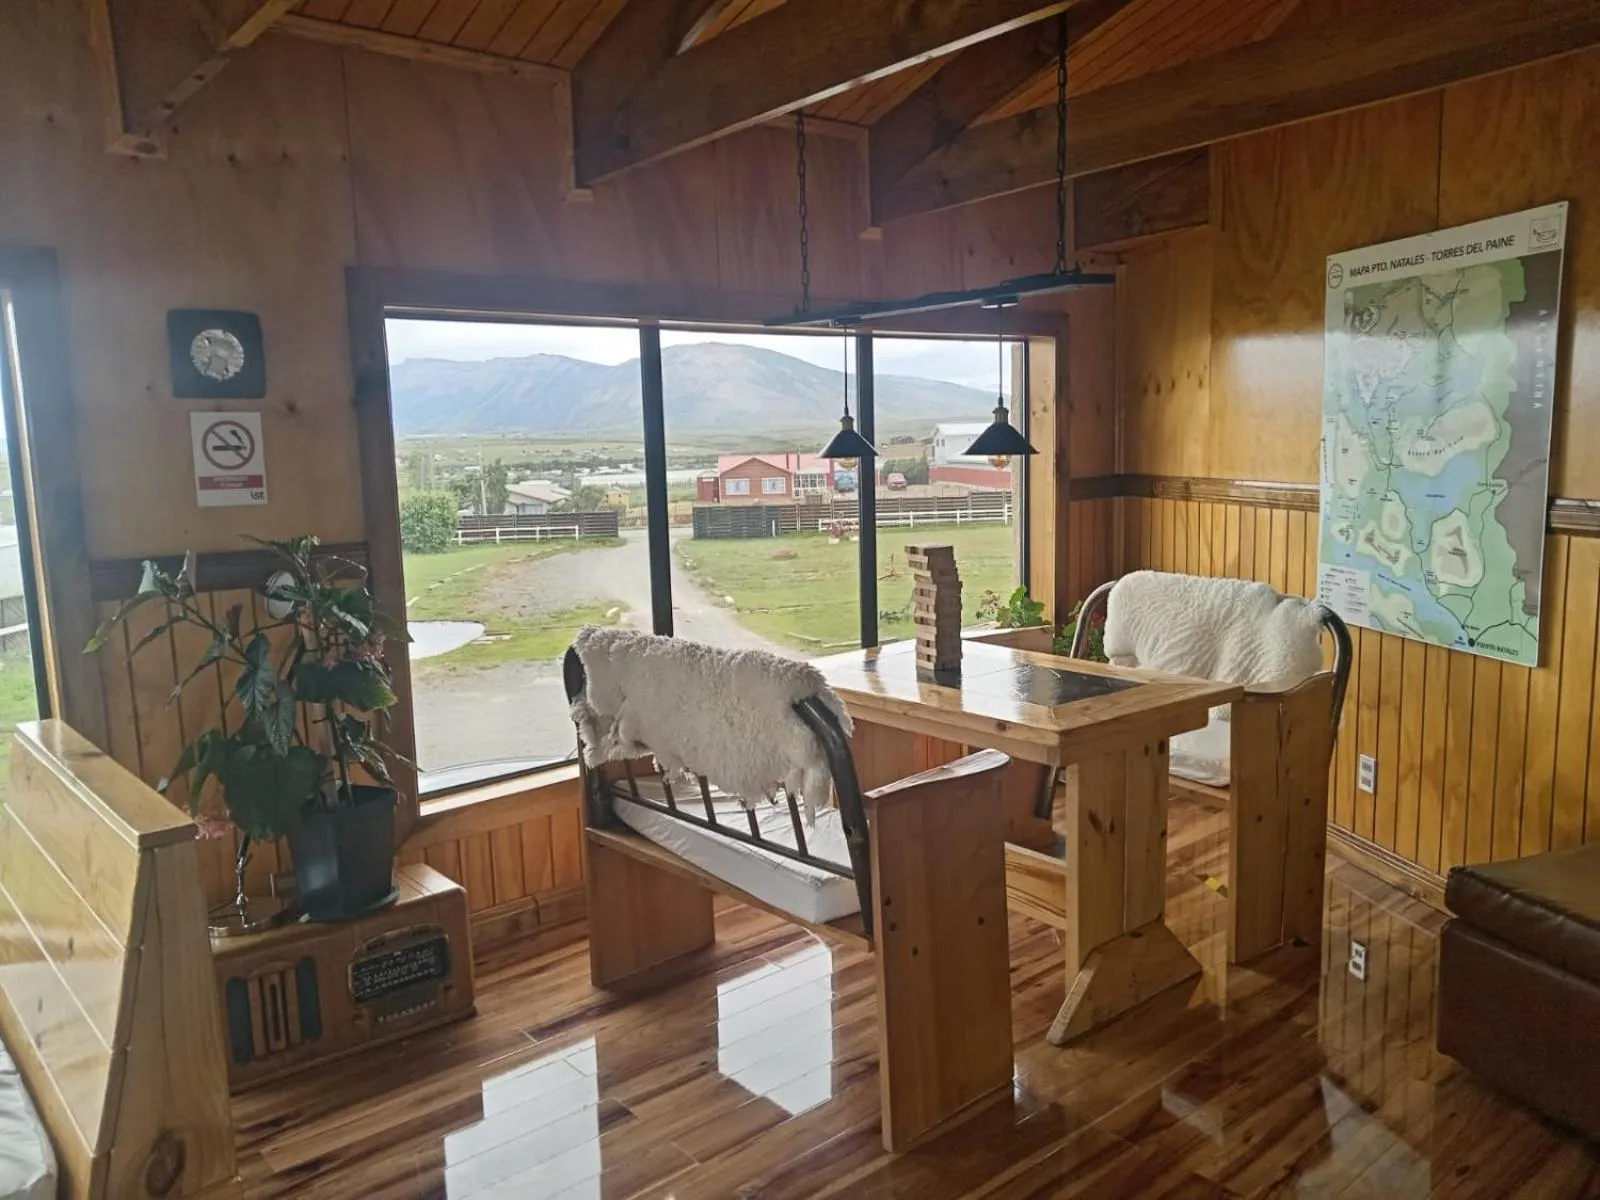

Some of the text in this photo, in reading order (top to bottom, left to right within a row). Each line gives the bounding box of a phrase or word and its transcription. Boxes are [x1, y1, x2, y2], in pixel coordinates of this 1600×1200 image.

[1349, 265, 1371, 278] MAPA
[1371, 262, 1388, 274] PTO.
[1390, 254, 1425, 269] NATALES
[1431, 246, 1465, 263] TORRES
[1466, 241, 1484, 256] DEL
[1485, 234, 1516, 250] PAINE
